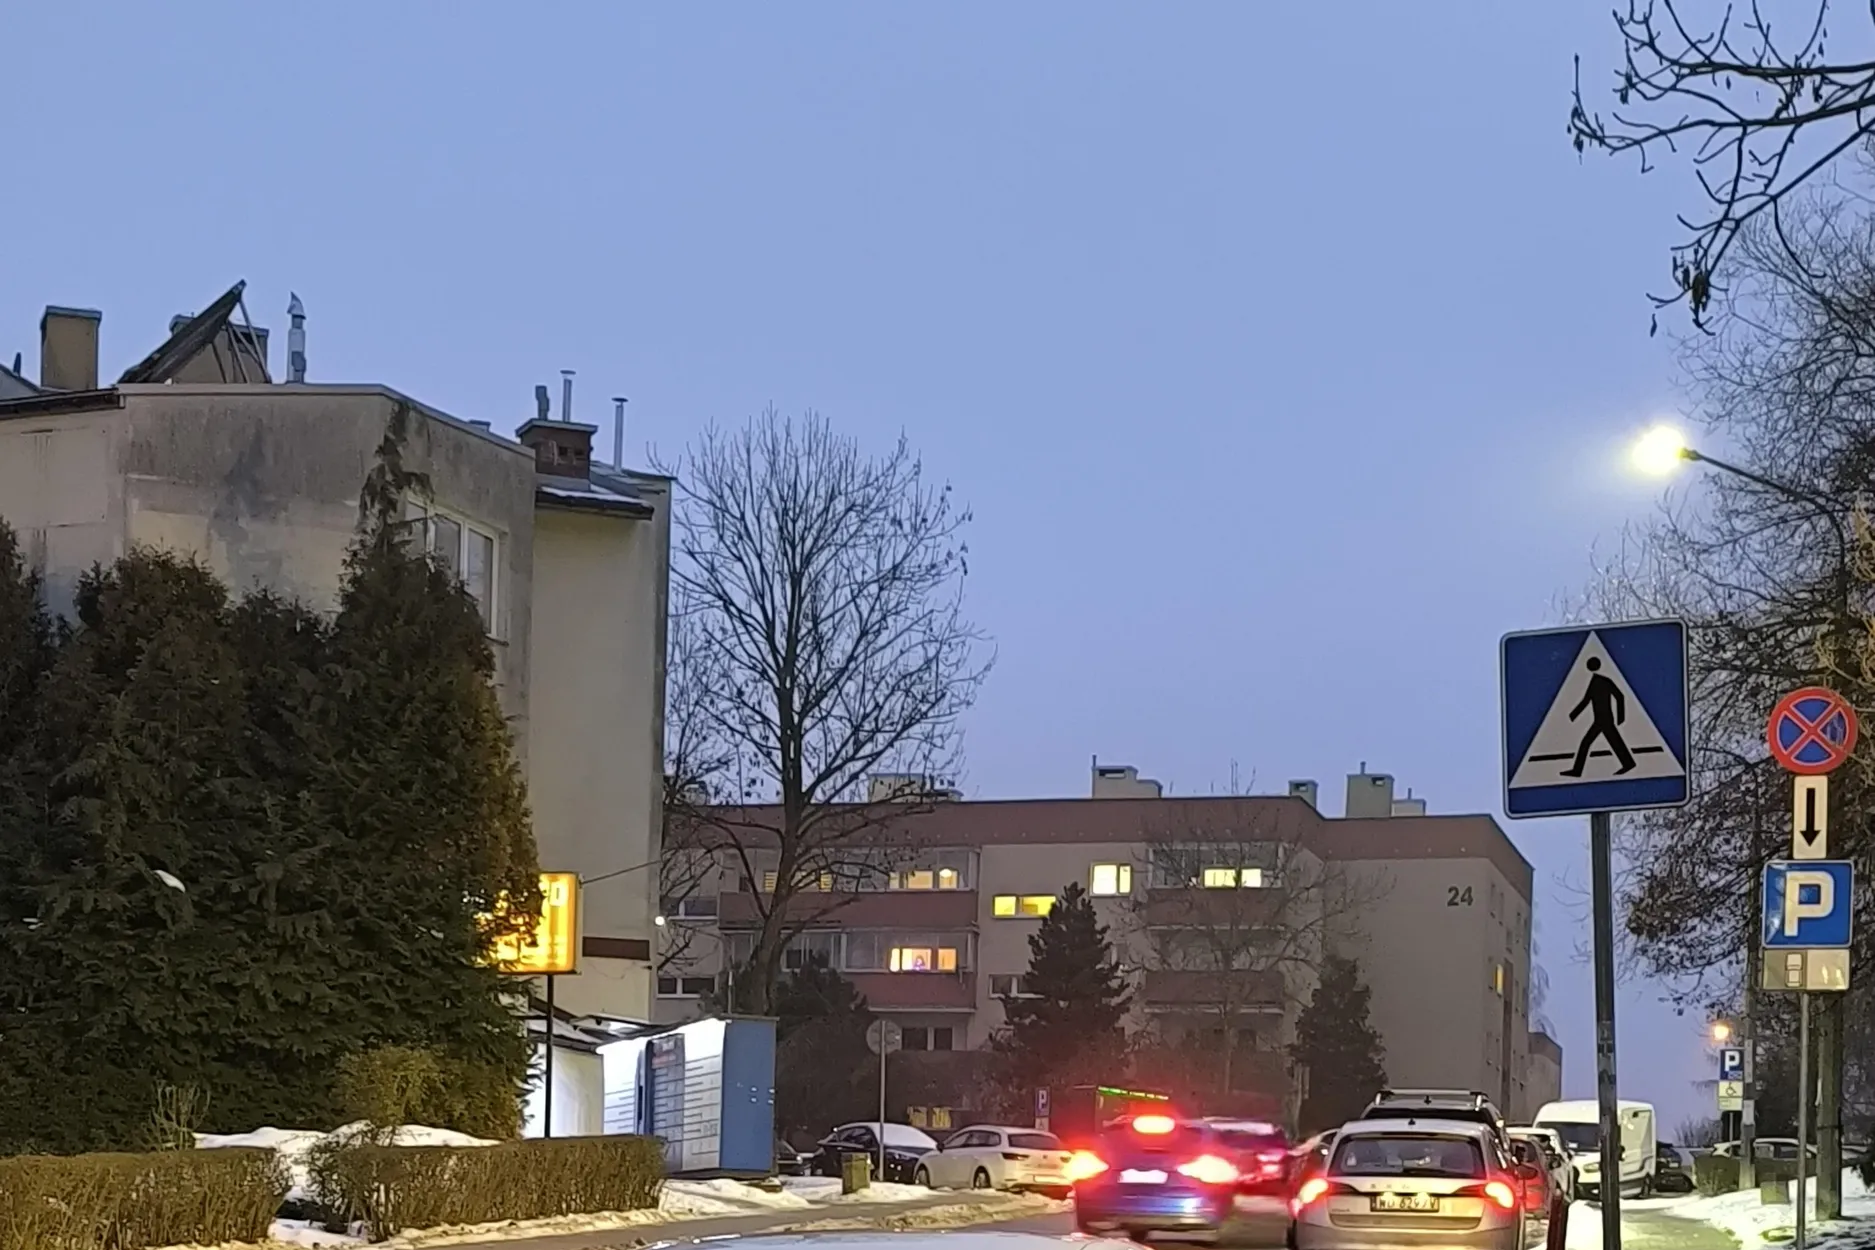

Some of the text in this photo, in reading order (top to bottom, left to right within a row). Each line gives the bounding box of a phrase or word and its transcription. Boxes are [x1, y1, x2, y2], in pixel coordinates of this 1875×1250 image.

[1447, 885, 1474, 907] 24
[1783, 870, 1835, 937] P
[1724, 1050, 1741, 1072] P
[1038, 1089, 1048, 1109] P
